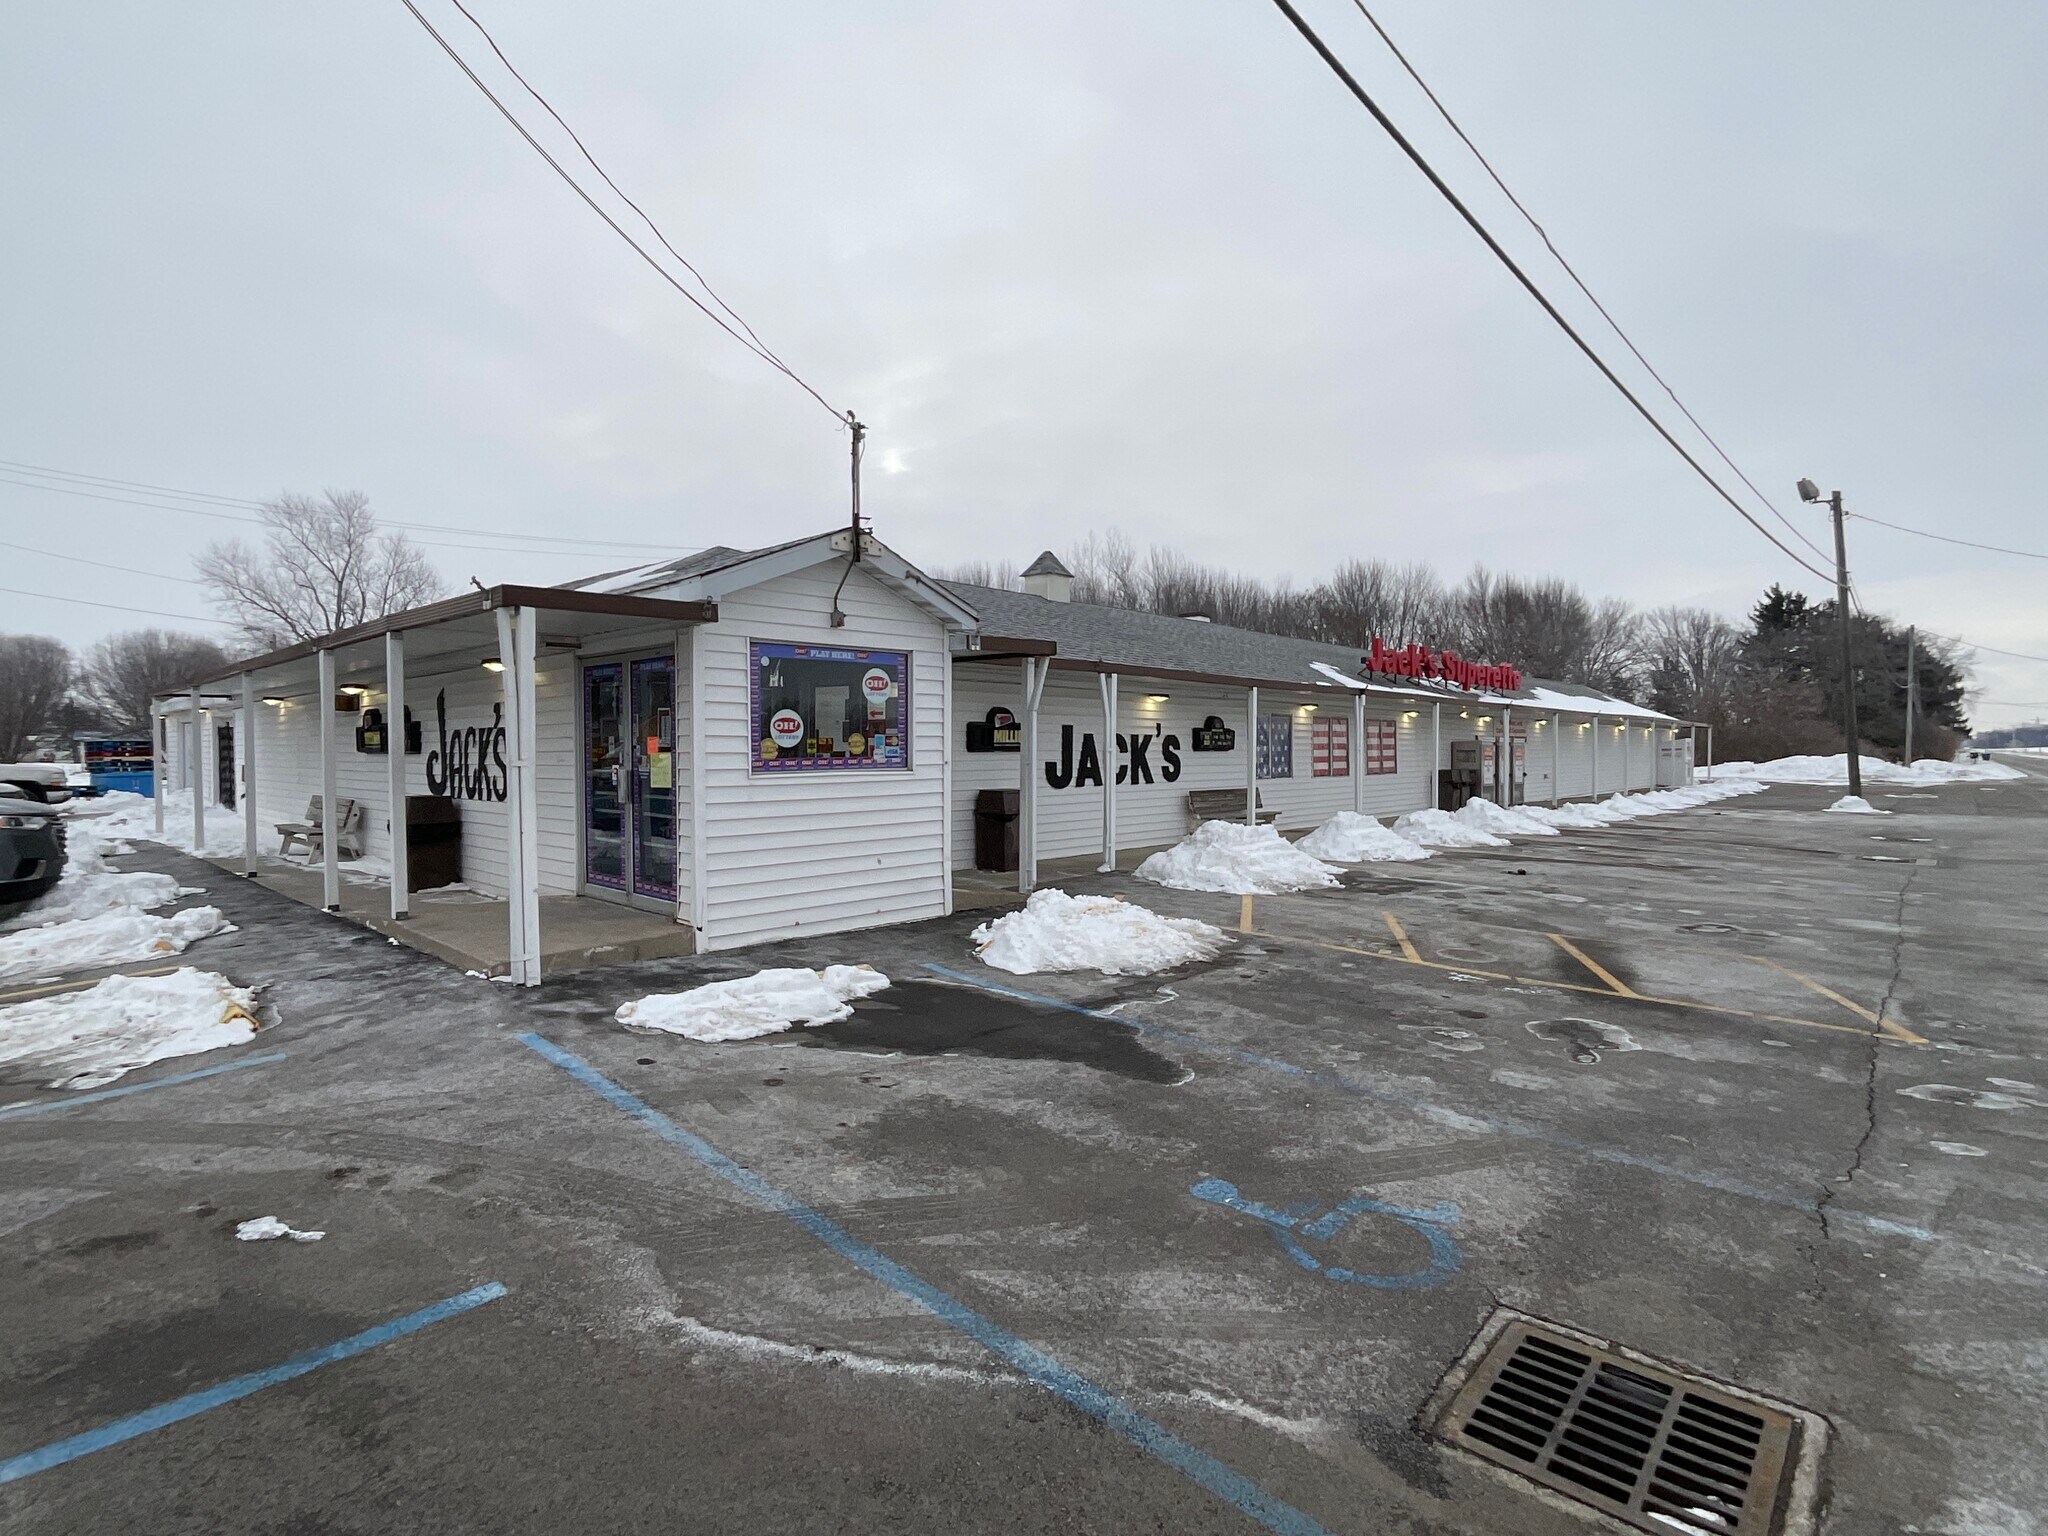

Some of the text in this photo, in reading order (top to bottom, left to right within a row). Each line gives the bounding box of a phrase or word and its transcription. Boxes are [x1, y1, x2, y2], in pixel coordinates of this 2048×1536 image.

[810, 649, 831, 658] PLAY
[1365, 637, 1522, 692] Jack's Superette
[866, 679, 887, 688] OH!
[774, 720, 799, 730] OH!
[993, 730, 1021, 743] MILLI
